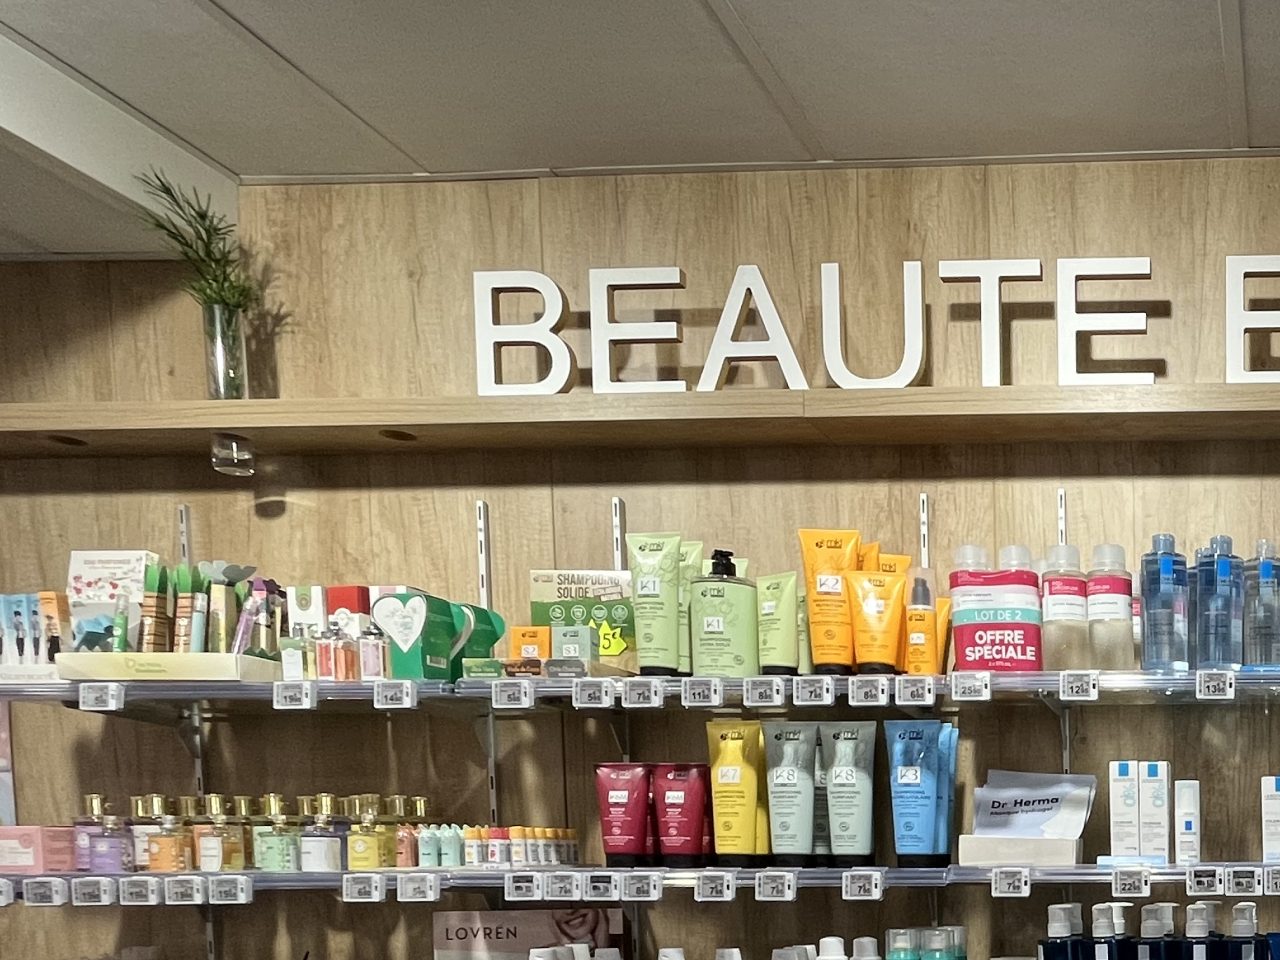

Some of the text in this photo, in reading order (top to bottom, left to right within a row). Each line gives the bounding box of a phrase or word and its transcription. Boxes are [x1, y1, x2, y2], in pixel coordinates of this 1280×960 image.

[473, 256, 1156, 396] BEAUTE
[557, 586, 590, 599] SOLIDE
[975, 611, 1022, 621] LOT DE 2
[975, 630, 1025, 644] OFFRE
[991, 797, 1060, 809] Dr Herma
